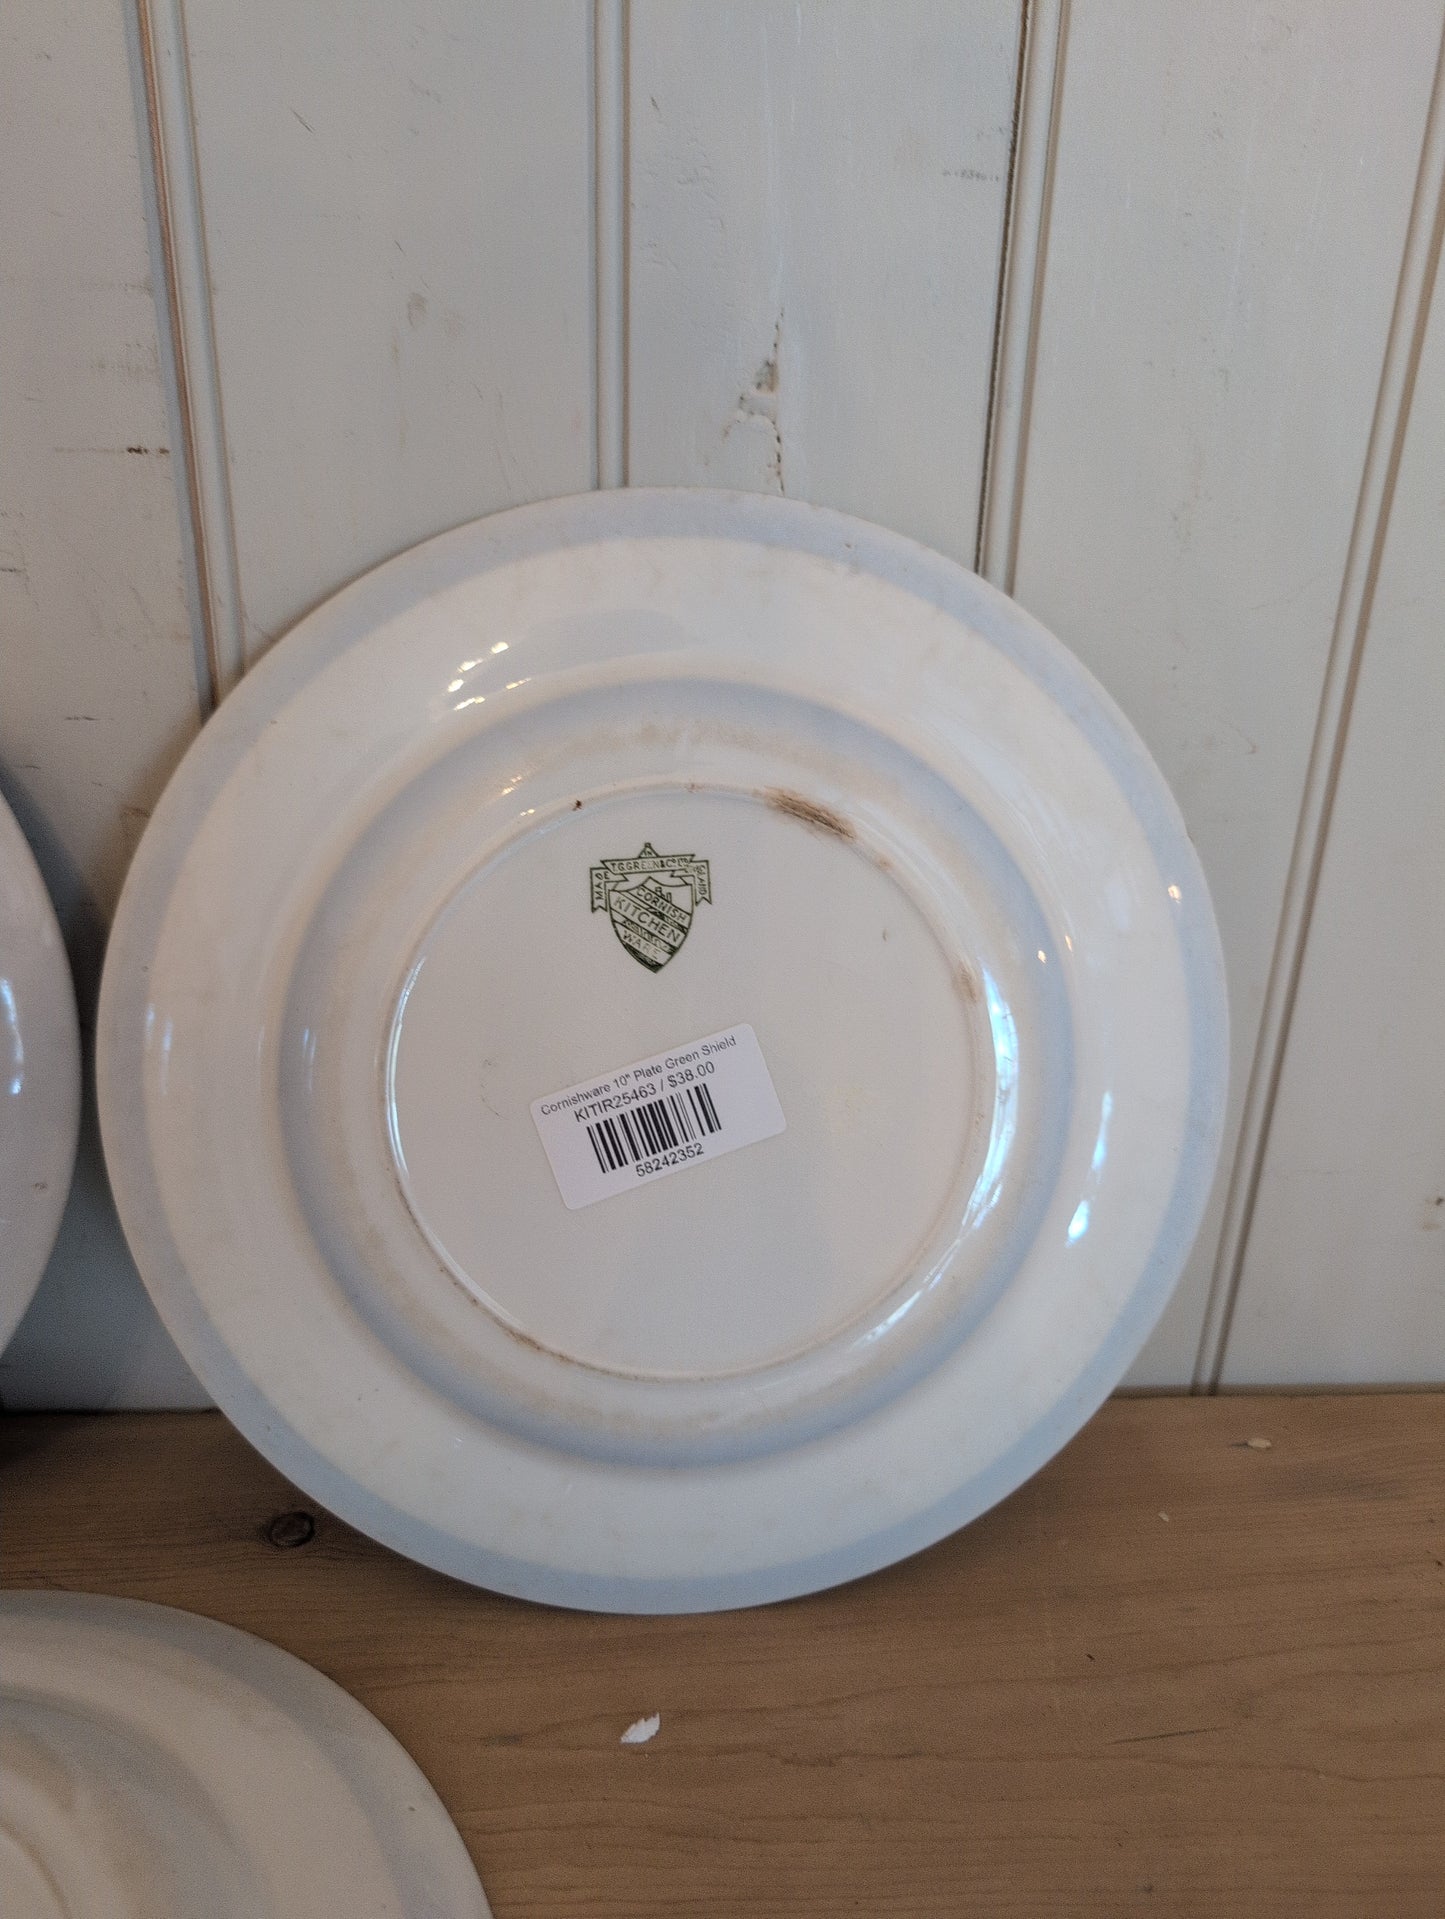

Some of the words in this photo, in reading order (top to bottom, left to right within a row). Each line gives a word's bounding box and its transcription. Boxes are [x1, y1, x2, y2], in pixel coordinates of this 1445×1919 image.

[595, 872, 610, 900] MADE
[614, 895, 681, 942] KITCHEN
[636, 887, 688, 922] CORNISH
[623, 930, 662, 960] WARE
[541, 1084, 611, 1115] Cornishware
[613, 1073, 631, 1088] 10"
[633, 1064, 663, 1081] Plate
[664, 1050, 700, 1069] Green
[701, 1035, 737, 1056] Shield
[574, 1083, 657, 1122] KITIR25463
[667, 1061, 715, 1089] $38.00
[636, 1143, 704, 1177] 58242352
